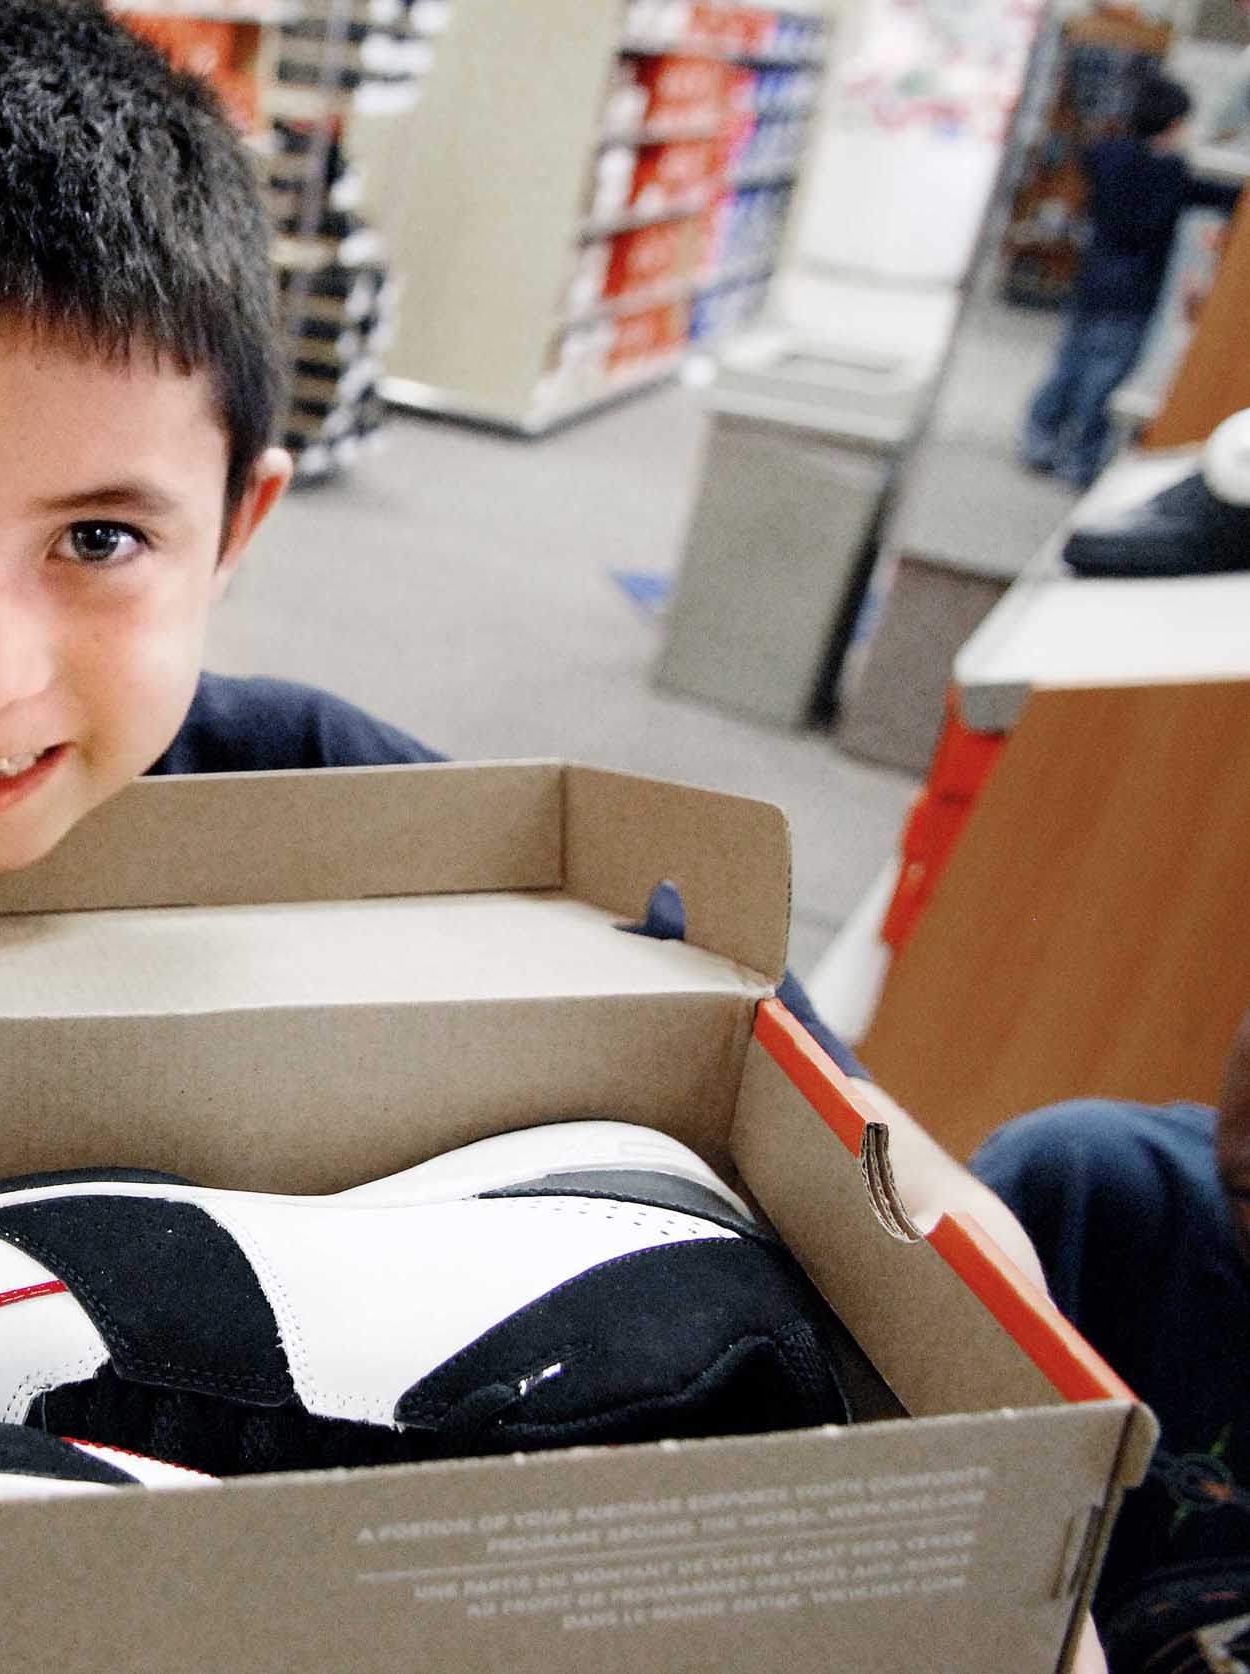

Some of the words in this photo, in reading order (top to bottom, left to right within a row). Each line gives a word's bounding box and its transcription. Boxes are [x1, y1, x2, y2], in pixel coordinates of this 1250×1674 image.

[356, 1528, 373, 1543] A
[377, 1518, 470, 1541] PORTION
[477, 1514, 507, 1531] OF
[513, 1508, 567, 1528] YOUR
[795, 1479, 862, 1499] YOUTH
[700, 1514, 733, 1531] THE
